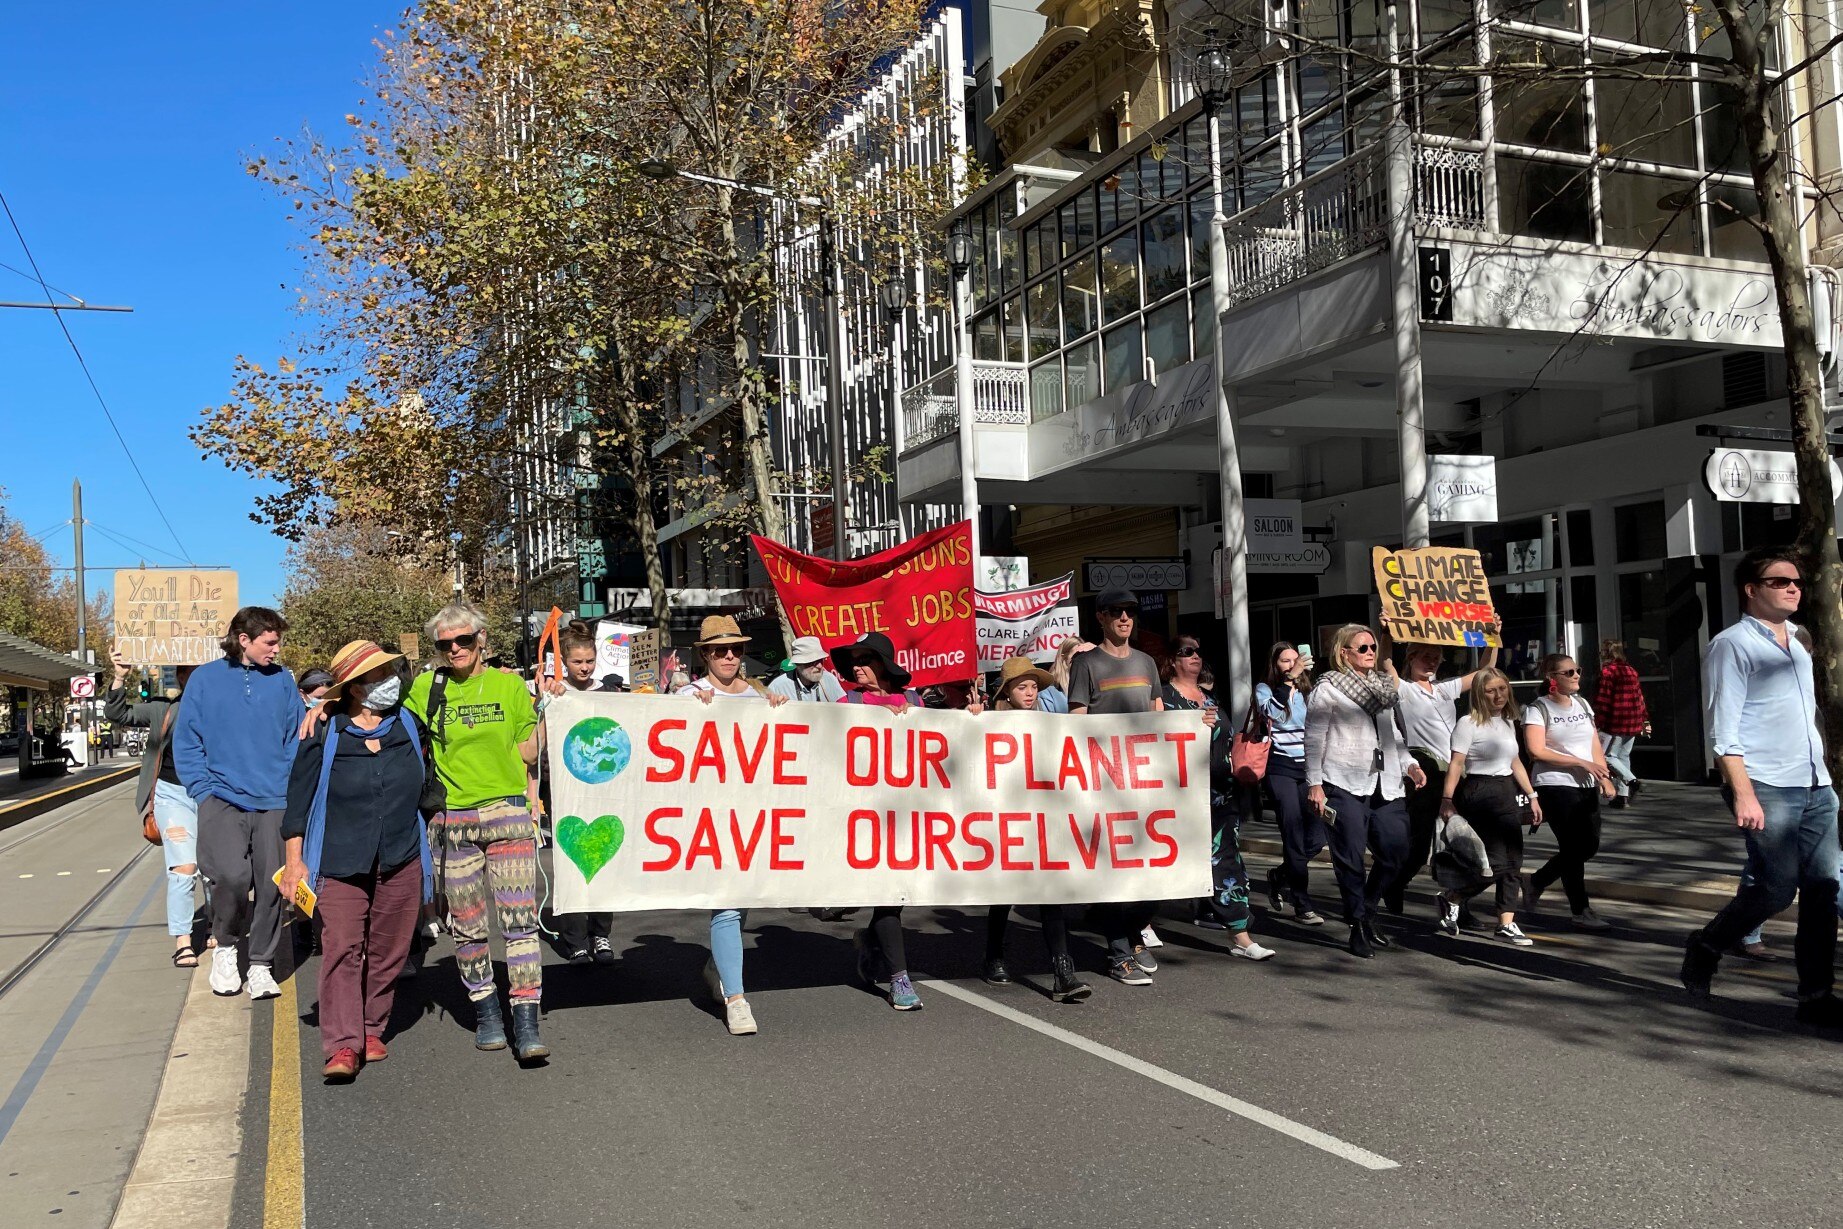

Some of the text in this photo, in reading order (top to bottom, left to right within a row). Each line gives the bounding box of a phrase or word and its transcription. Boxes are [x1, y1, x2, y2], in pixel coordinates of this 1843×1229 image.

[1429, 253, 1443, 315] 107
[1570, 268, 1768, 340] Ambassadors
[1753, 472, 1798, 483] ACCOMMO
[1437, 484, 1485, 495] GAMING
[1254, 519, 1294, 533] SALOON
[1381, 554, 1485, 581] CLIMATE
[190, 574, 222, 601] Die
[1386, 578, 1488, 606] CHANGE
[128, 603, 147, 620] of
[793, 600, 890, 637] CREATE
[905, 587, 973, 627] JOBS
[1392, 600, 1494, 623] IS WORSE
[975, 627, 1020, 640] CLARE
[1389, 617, 1499, 640] THAN YEAR
[605, 644, 629, 654] Climat
[631, 648, 658, 660] BETTER
[897, 649, 966, 672] Alliance
[459, 704, 497, 716] extinction
[471, 711, 504, 723] rebellion
[645, 719, 1197, 792] SAVE OUR PLANET
[642, 807, 1178, 872] SAVE OURSELVES
